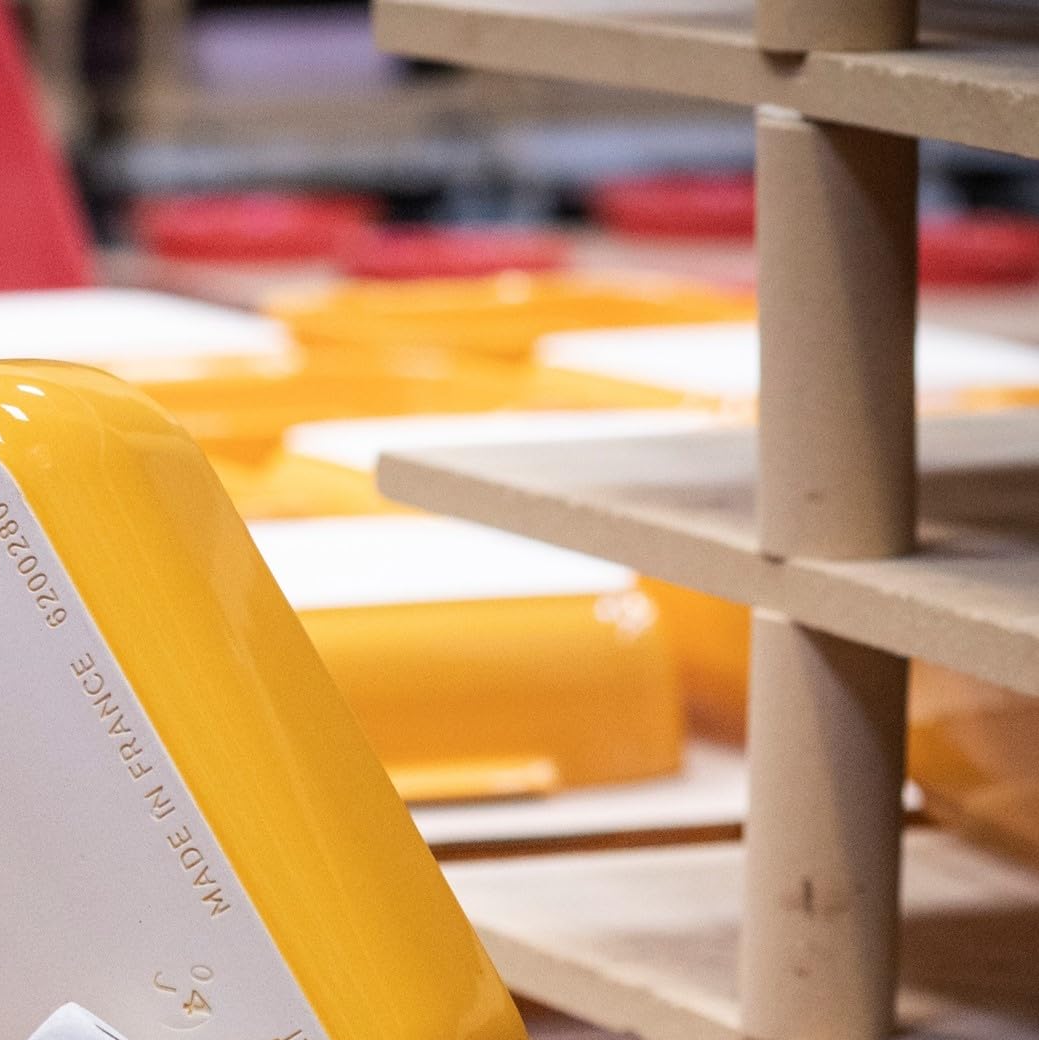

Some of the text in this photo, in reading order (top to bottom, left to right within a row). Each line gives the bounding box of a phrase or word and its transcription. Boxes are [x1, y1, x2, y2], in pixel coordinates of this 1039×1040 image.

[70, 653, 153, 780] FRANCE
[144, 785, 176, 820] IN
[167, 825, 230, 917] MADE
